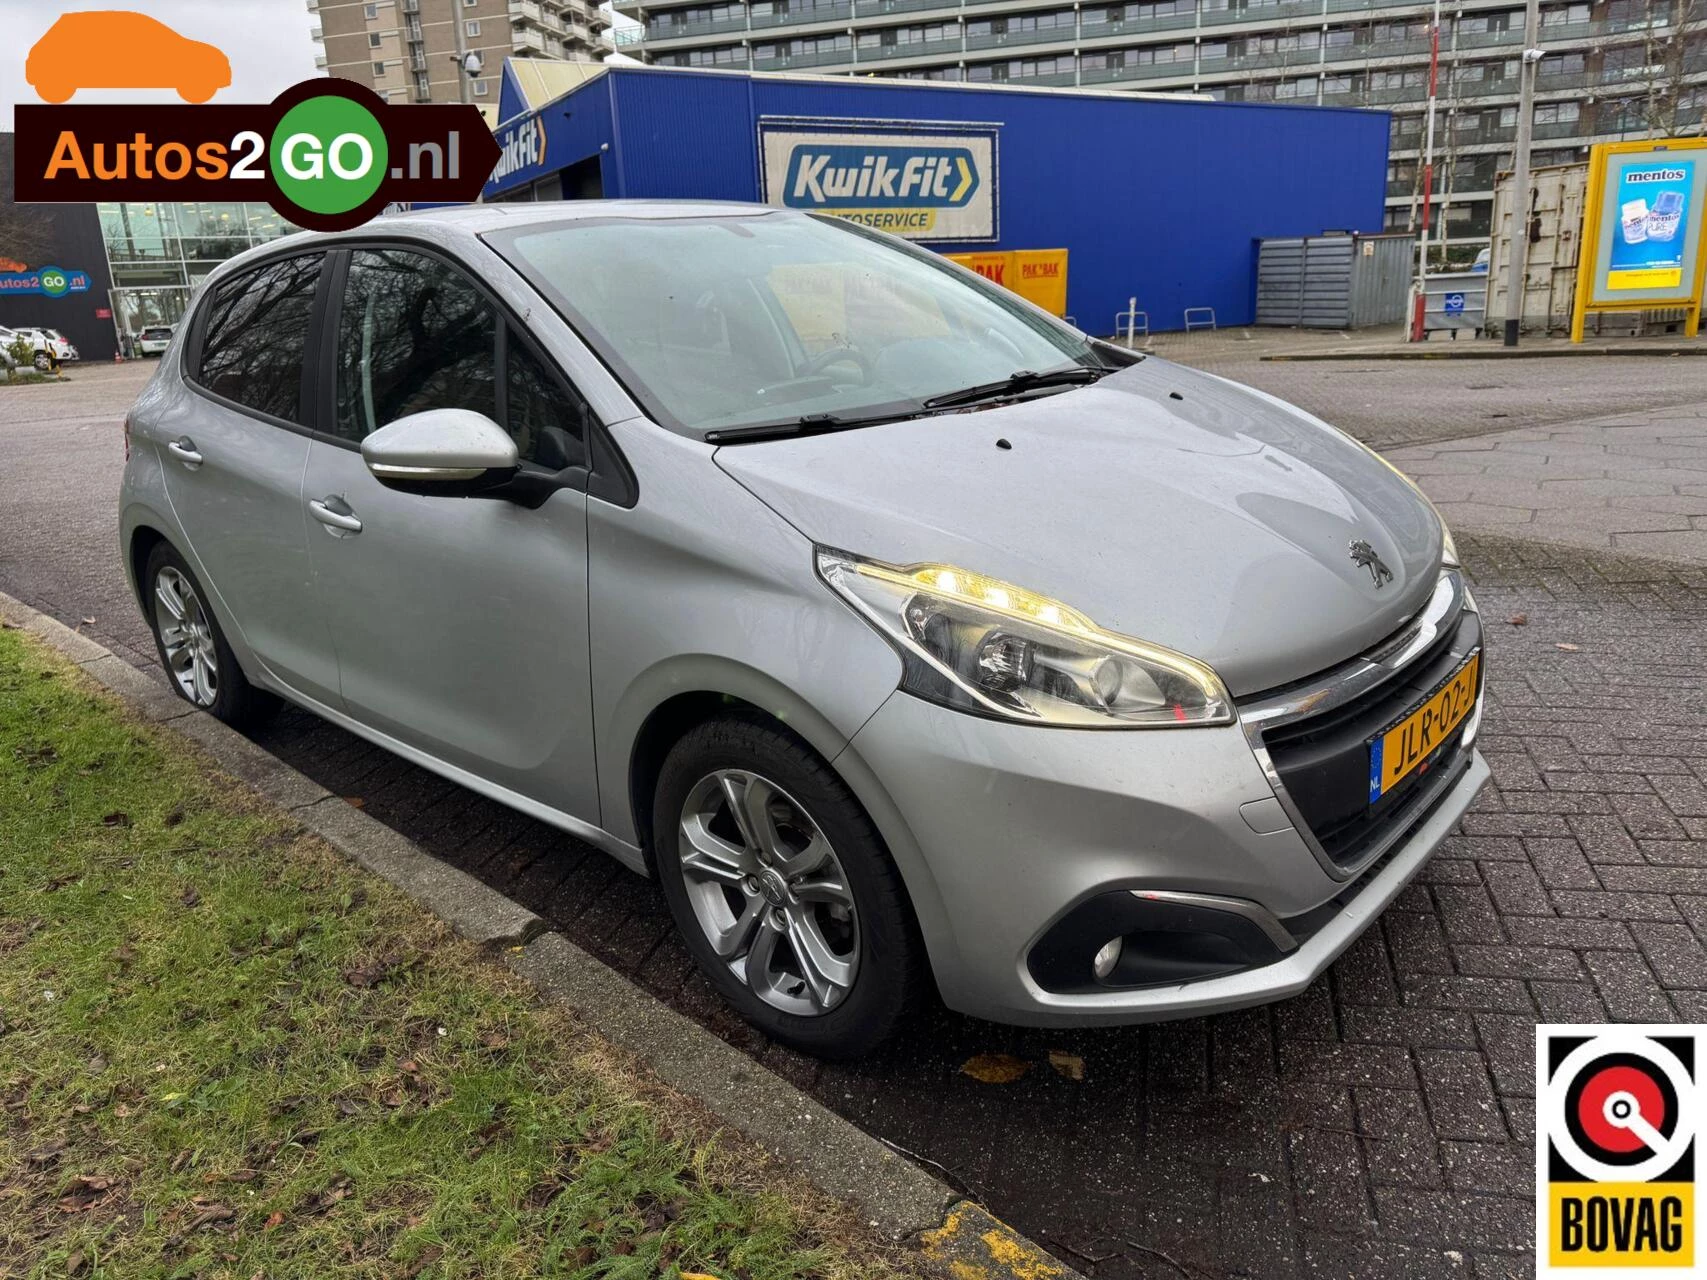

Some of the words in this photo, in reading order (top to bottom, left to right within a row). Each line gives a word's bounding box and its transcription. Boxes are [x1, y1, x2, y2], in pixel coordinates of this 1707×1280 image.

[1627, 170, 1686, 182] mentos
[838, 213, 928, 228] OSERVICE
[1394, 665, 1474, 776] JLR-02-J
[1370, 777, 1380, 793] NL
